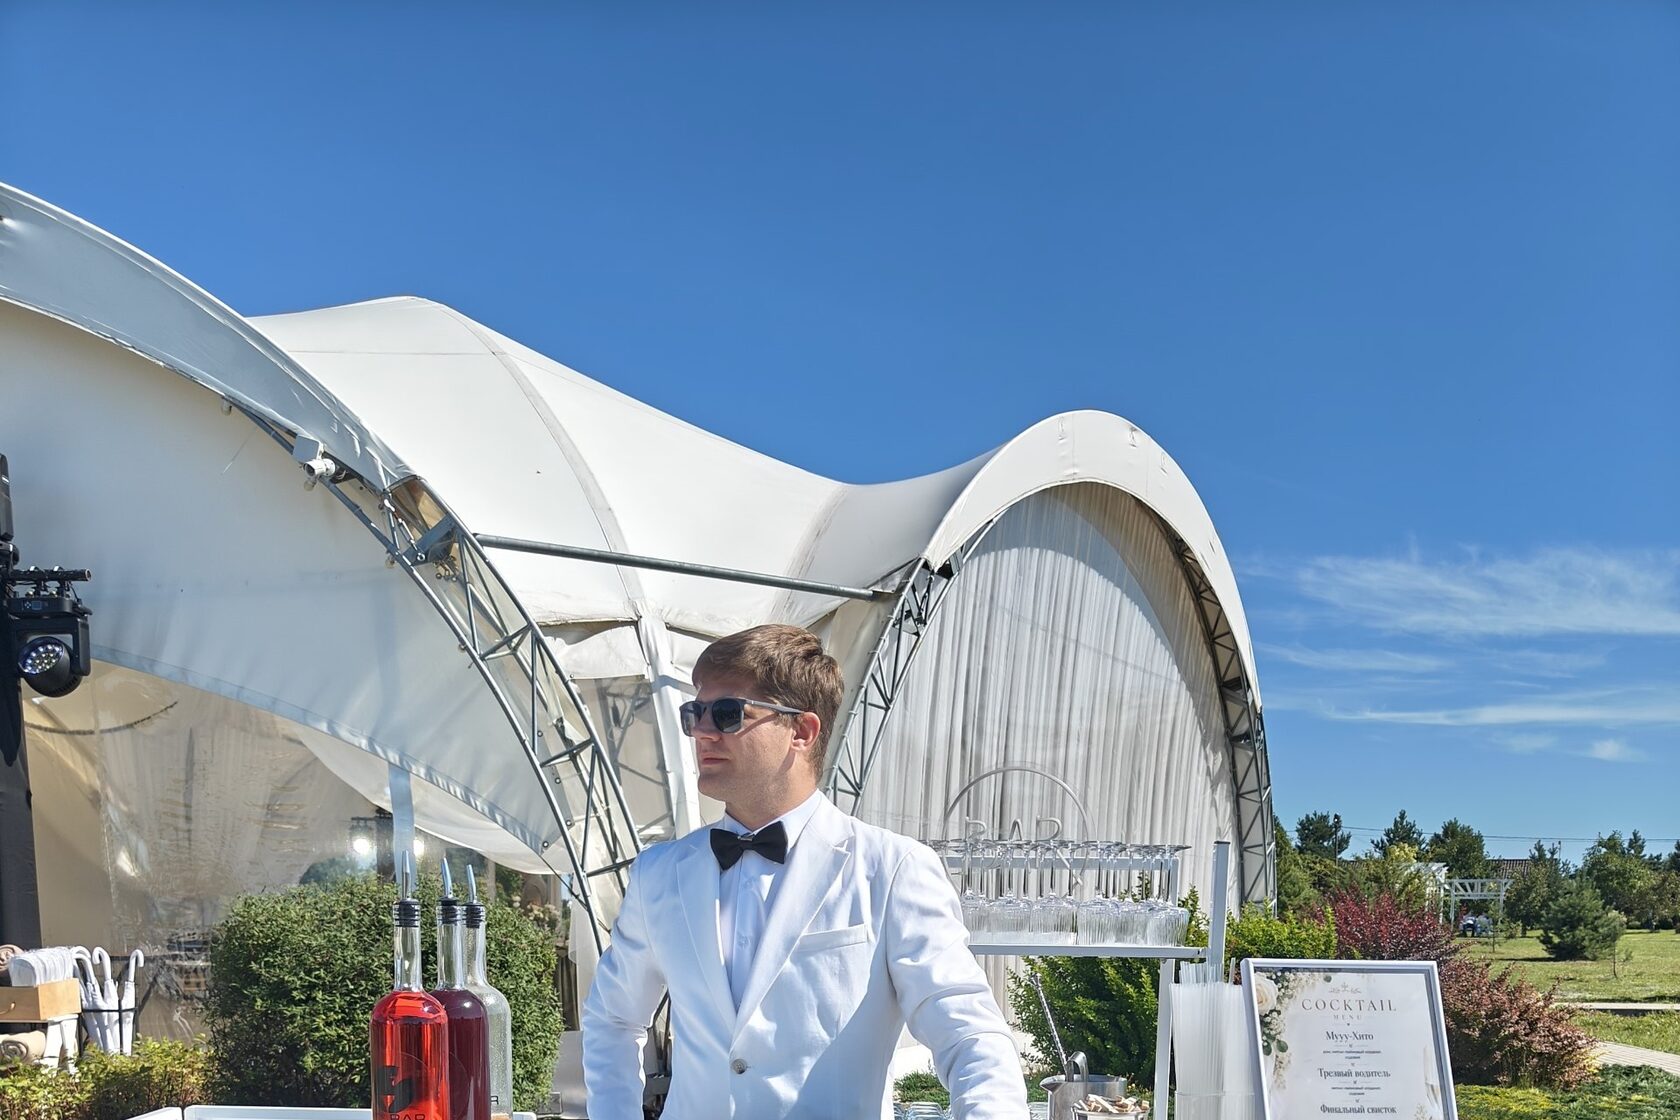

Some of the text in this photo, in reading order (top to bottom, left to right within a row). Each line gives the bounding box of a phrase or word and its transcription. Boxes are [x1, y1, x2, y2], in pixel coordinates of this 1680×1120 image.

[1301, 998, 1397, 1012] COCKTAIL
[1325, 1030, 1374, 1043] Мууу-Хито
[1317, 1067, 1391, 1080] Трезвый водитель
[1320, 1103, 1397, 1114] Финальный свисток
